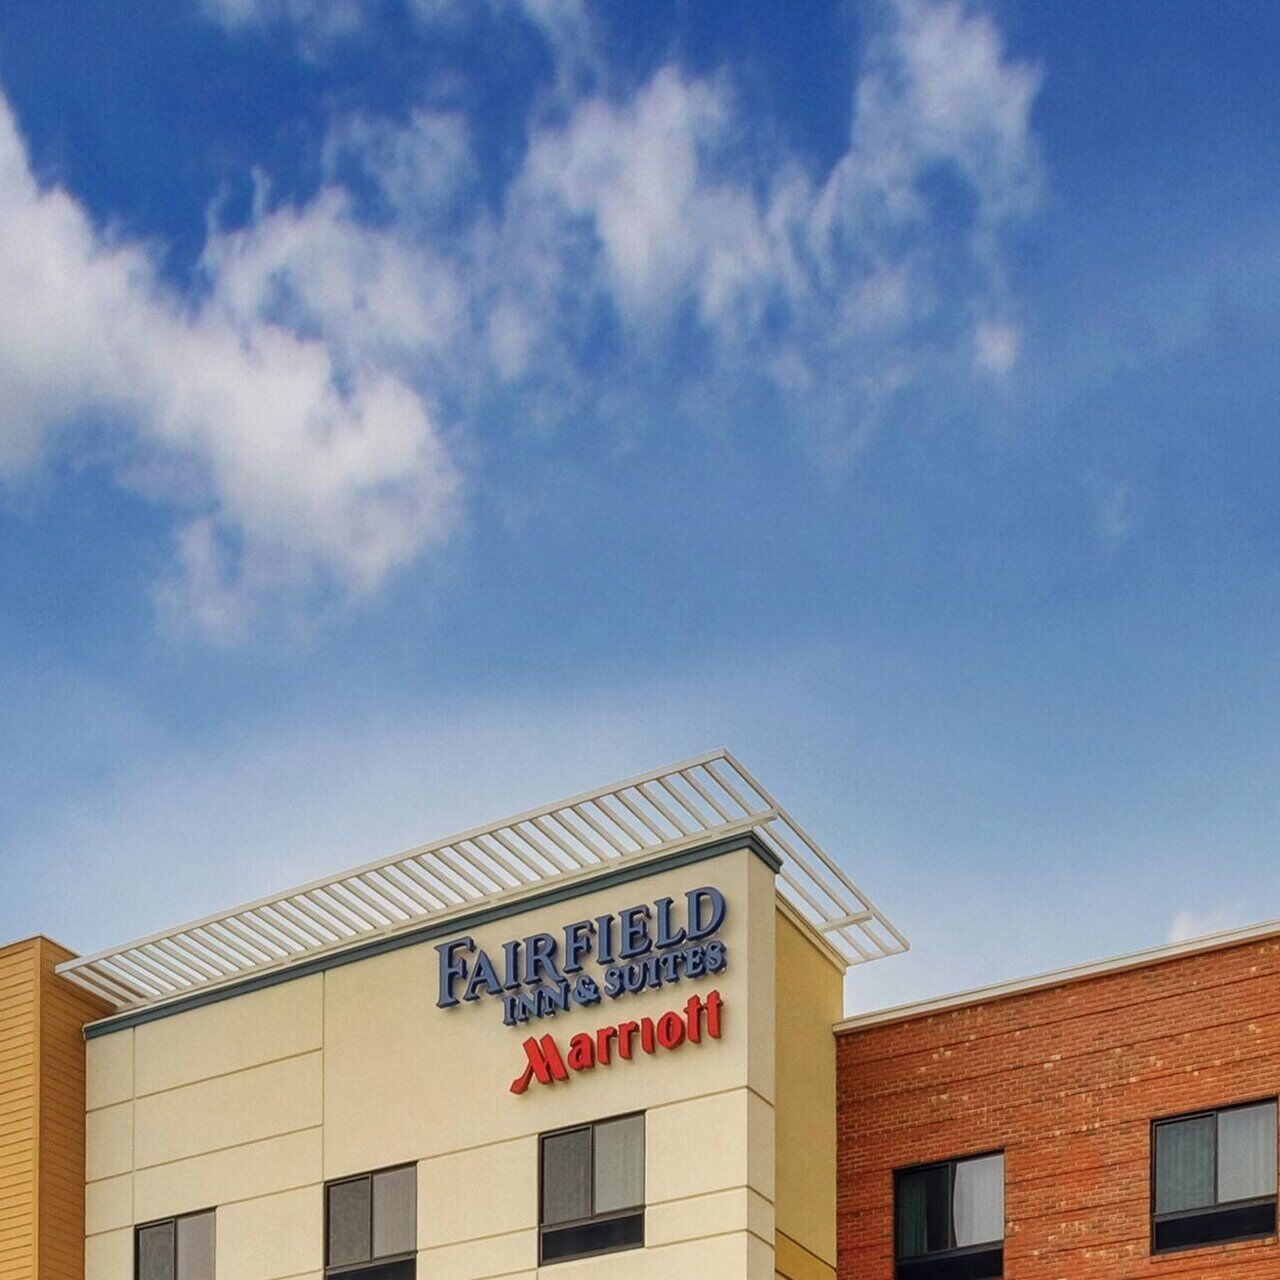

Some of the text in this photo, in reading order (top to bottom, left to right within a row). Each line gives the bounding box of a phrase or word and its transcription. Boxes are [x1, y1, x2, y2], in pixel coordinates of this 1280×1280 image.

[434, 886, 727, 1008] FAIRFIELD
[502, 941, 727, 1026] INN & SUITES
[509, 989, 724, 1095] Marriott
